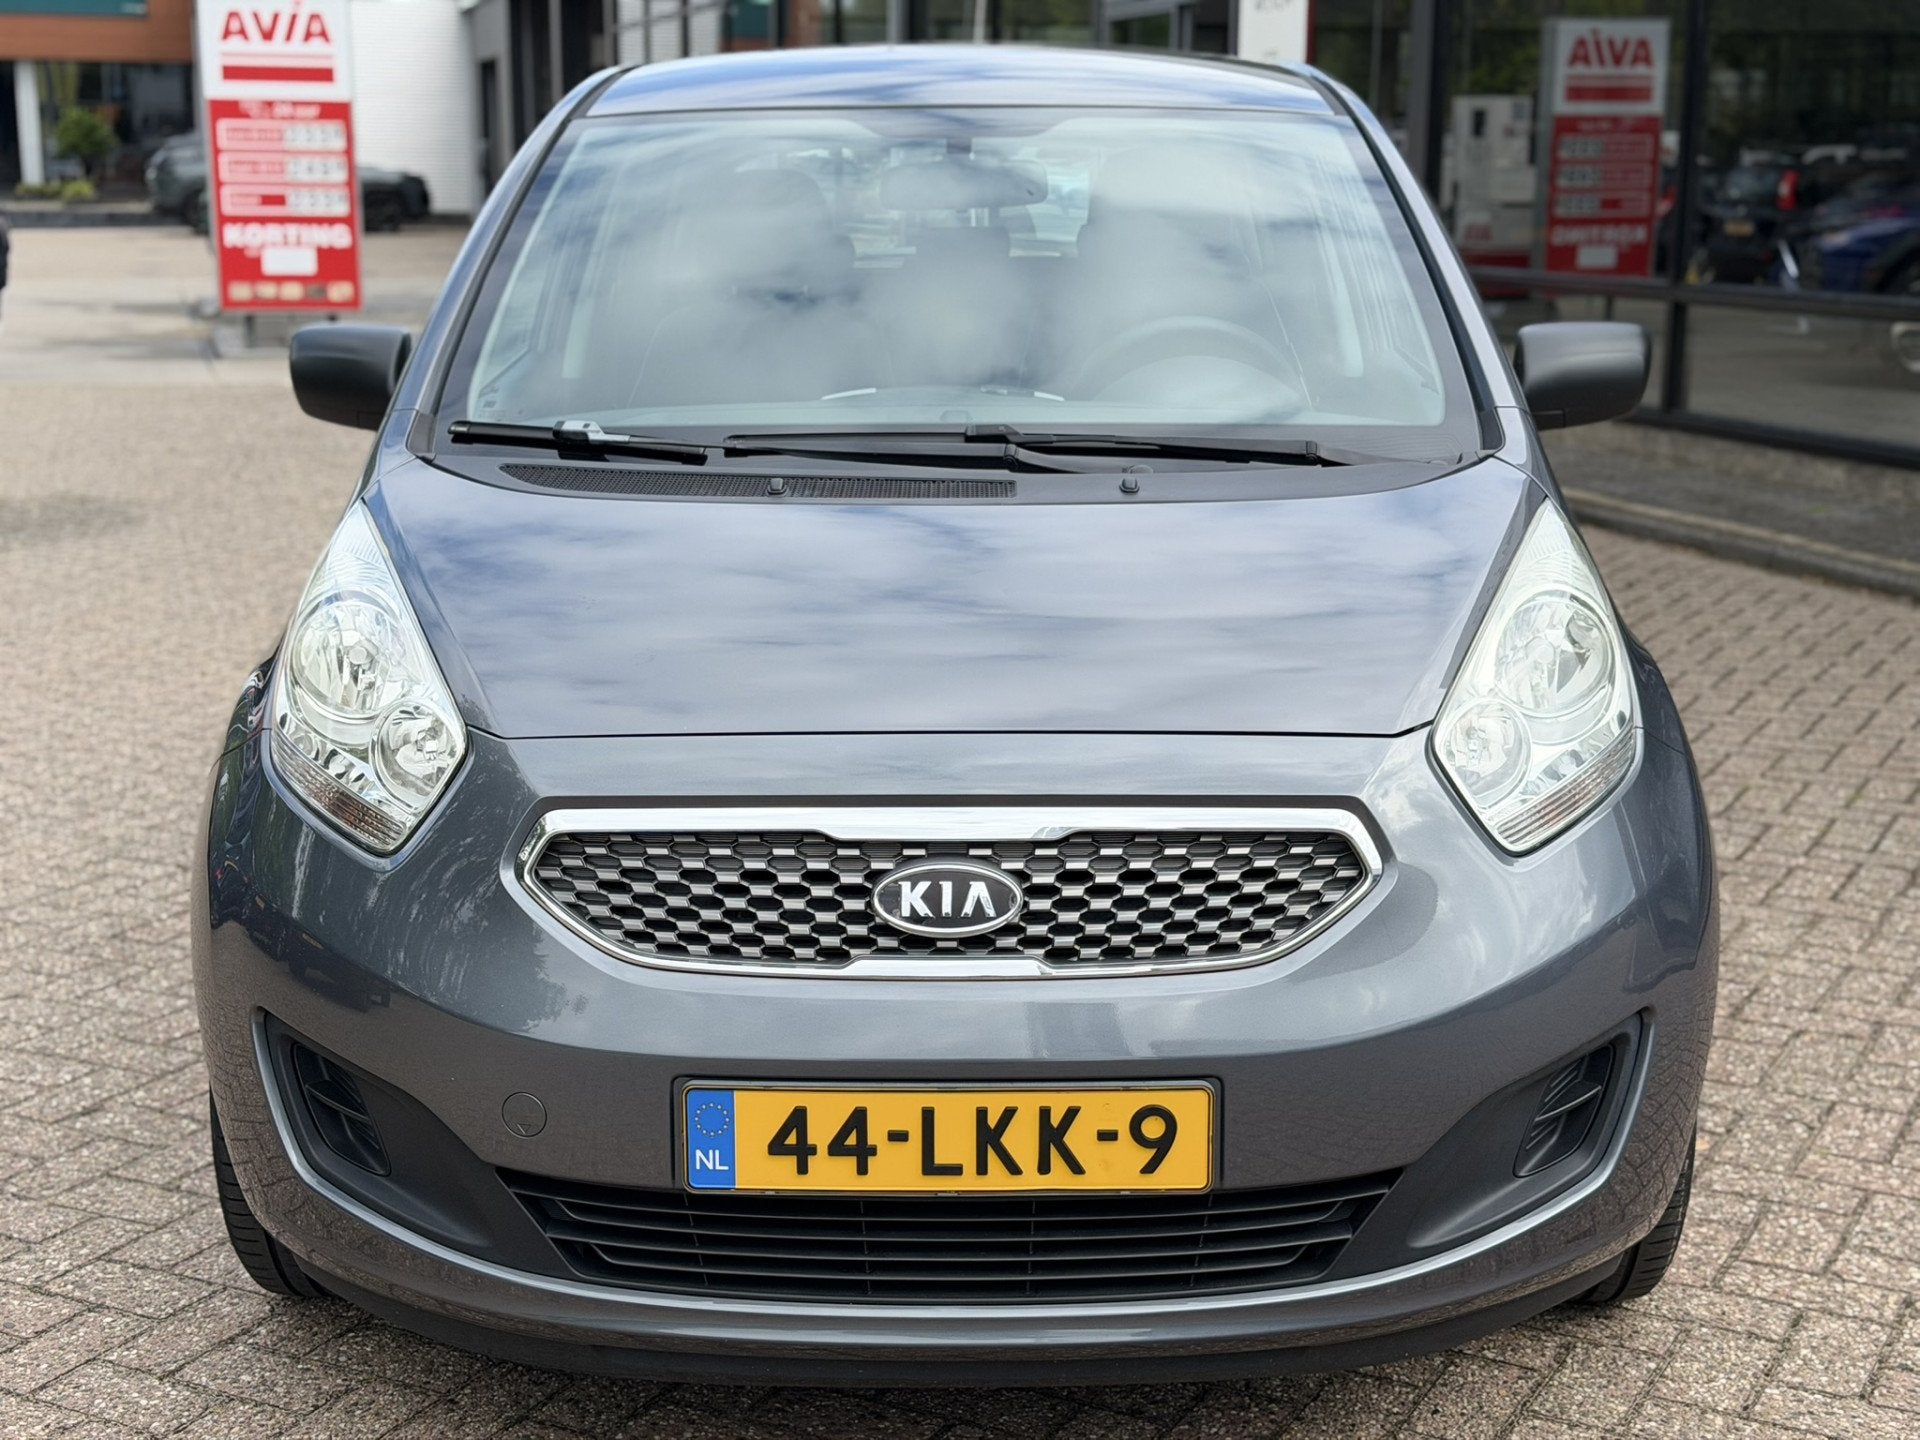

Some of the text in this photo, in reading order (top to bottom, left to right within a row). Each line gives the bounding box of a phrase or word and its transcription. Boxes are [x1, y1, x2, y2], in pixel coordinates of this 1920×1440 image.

[221, 0, 330, 42] AVIA
[898, 880, 997, 918] KIA
[766, 1104, 1179, 1176] 44-LKK-9
[695, 1150, 730, 1171] NL
